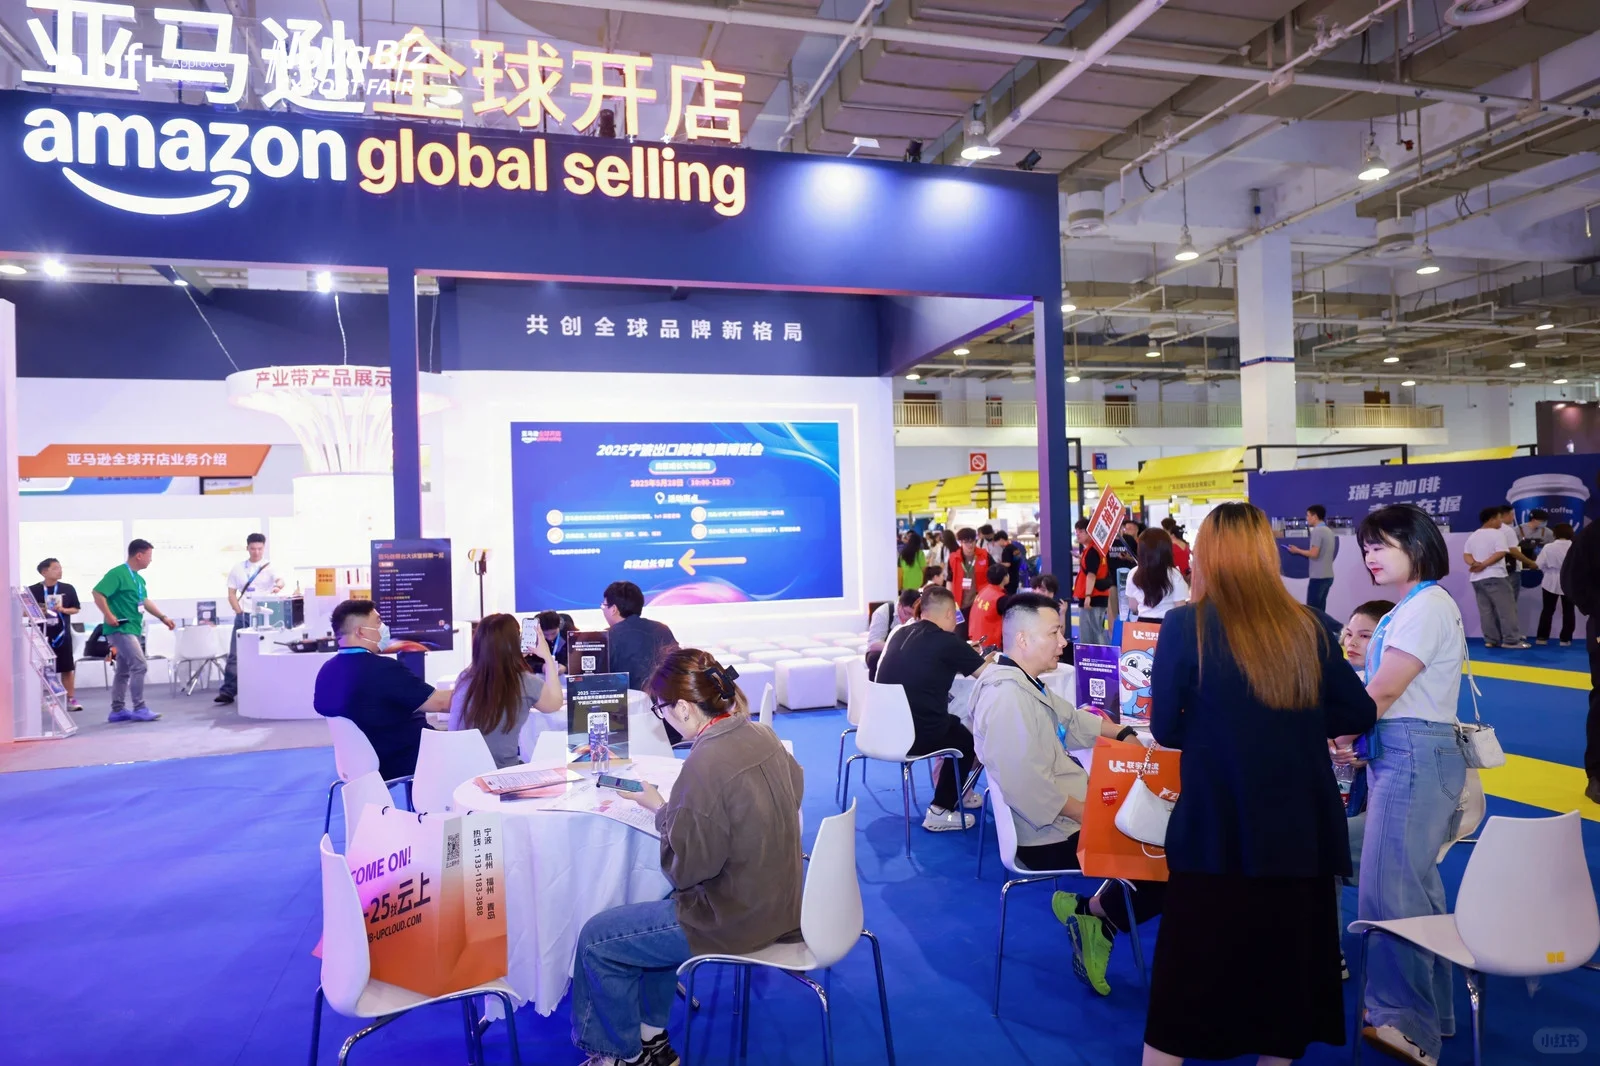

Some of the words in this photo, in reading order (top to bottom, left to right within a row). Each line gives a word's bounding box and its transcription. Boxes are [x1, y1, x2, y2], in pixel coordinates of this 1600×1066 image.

[22, 0, 746, 143] 亚马逊全球开店
[23, 108, 347, 181] amazon
[357, 128, 548, 194] global
[563, 147, 745, 217] selling
[526, 314, 803, 342] 共创全球品牌新格局
[256, 368, 391, 388] 产业带产品展示
[67, 453, 227, 466] 亚马逊全球开店业务介绍
[1348, 476, 1441, 501] 瑞幸咖啡
[1101, 495, 1120, 530] 抽奖
[1368, 496, 1462, 516] 在握
[1550, 506, 1573, 514] coffee
[484, 828, 492, 845] 宁波
[388, 846, 411, 872] ON!
[485, 853, 493, 869] 杭州
[486, 877, 494, 894] 福州
